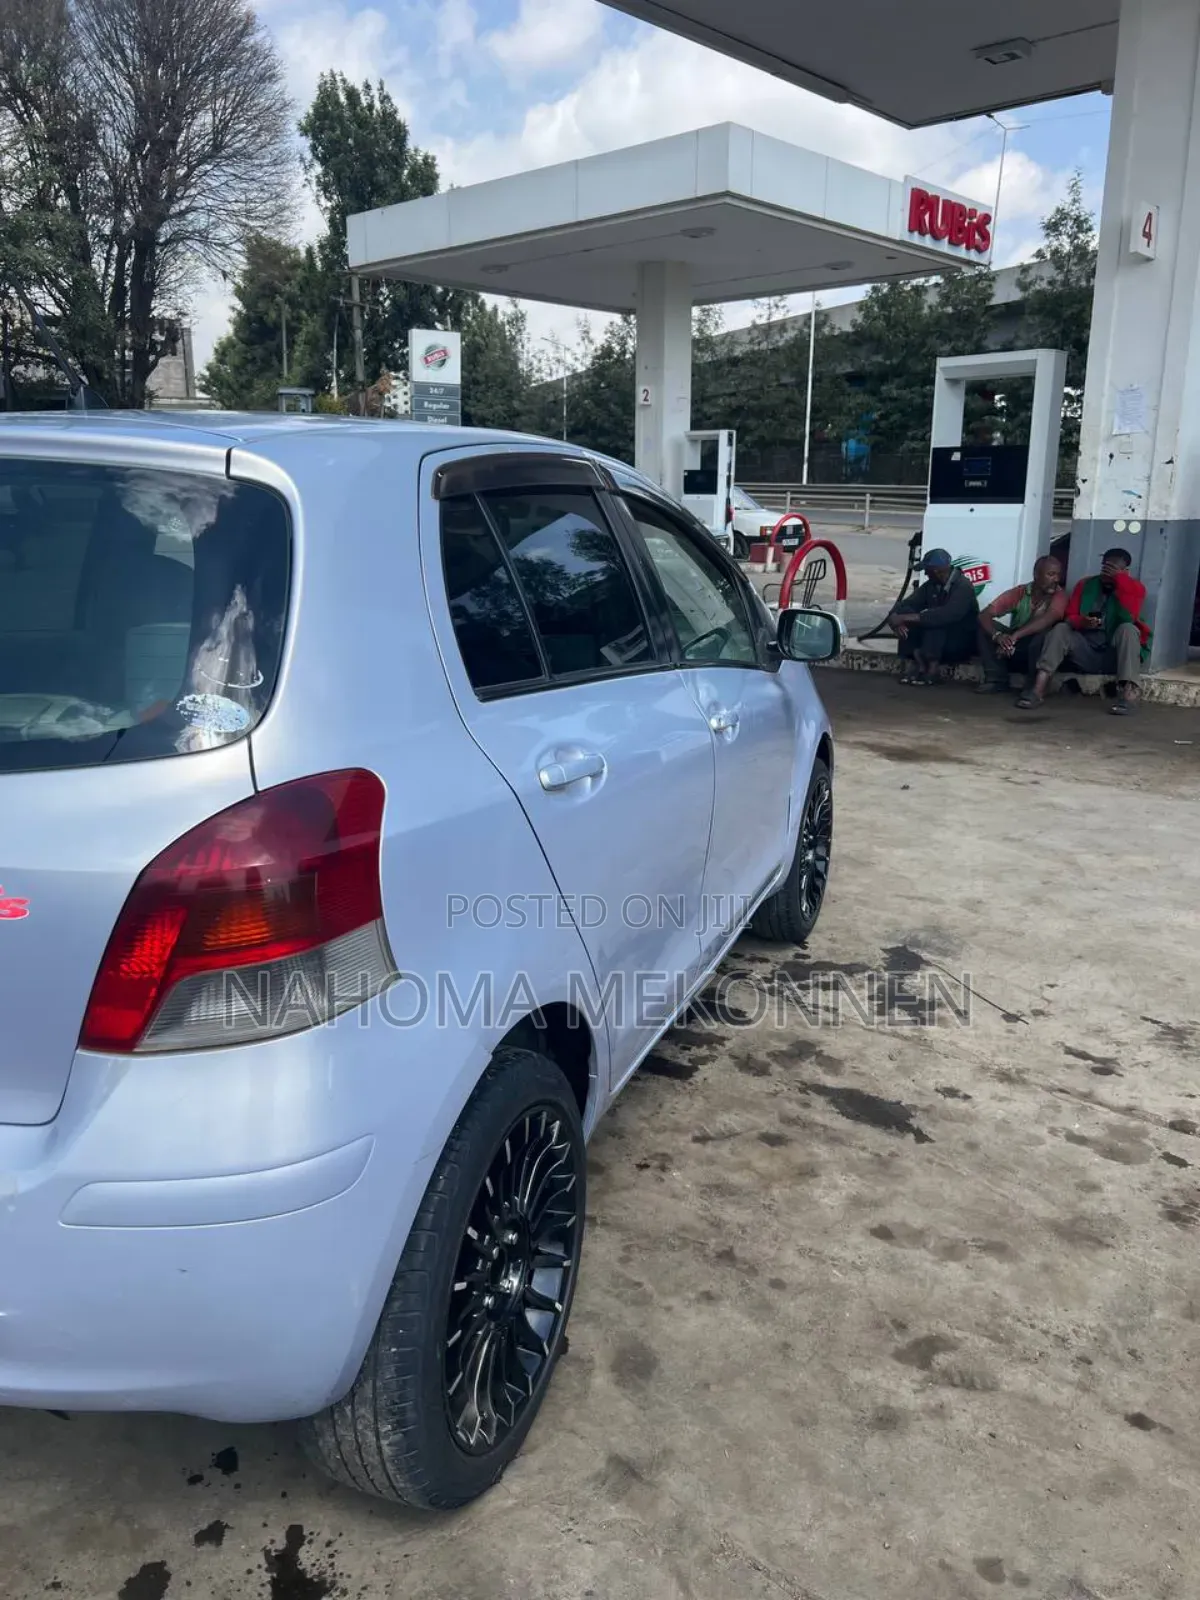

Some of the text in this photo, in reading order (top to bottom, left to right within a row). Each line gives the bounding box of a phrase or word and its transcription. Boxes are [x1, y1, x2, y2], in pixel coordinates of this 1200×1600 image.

[1142, 211, 1153, 248] 4
[642, 388, 650, 402] 2
[423, 401, 450, 411] Regular
